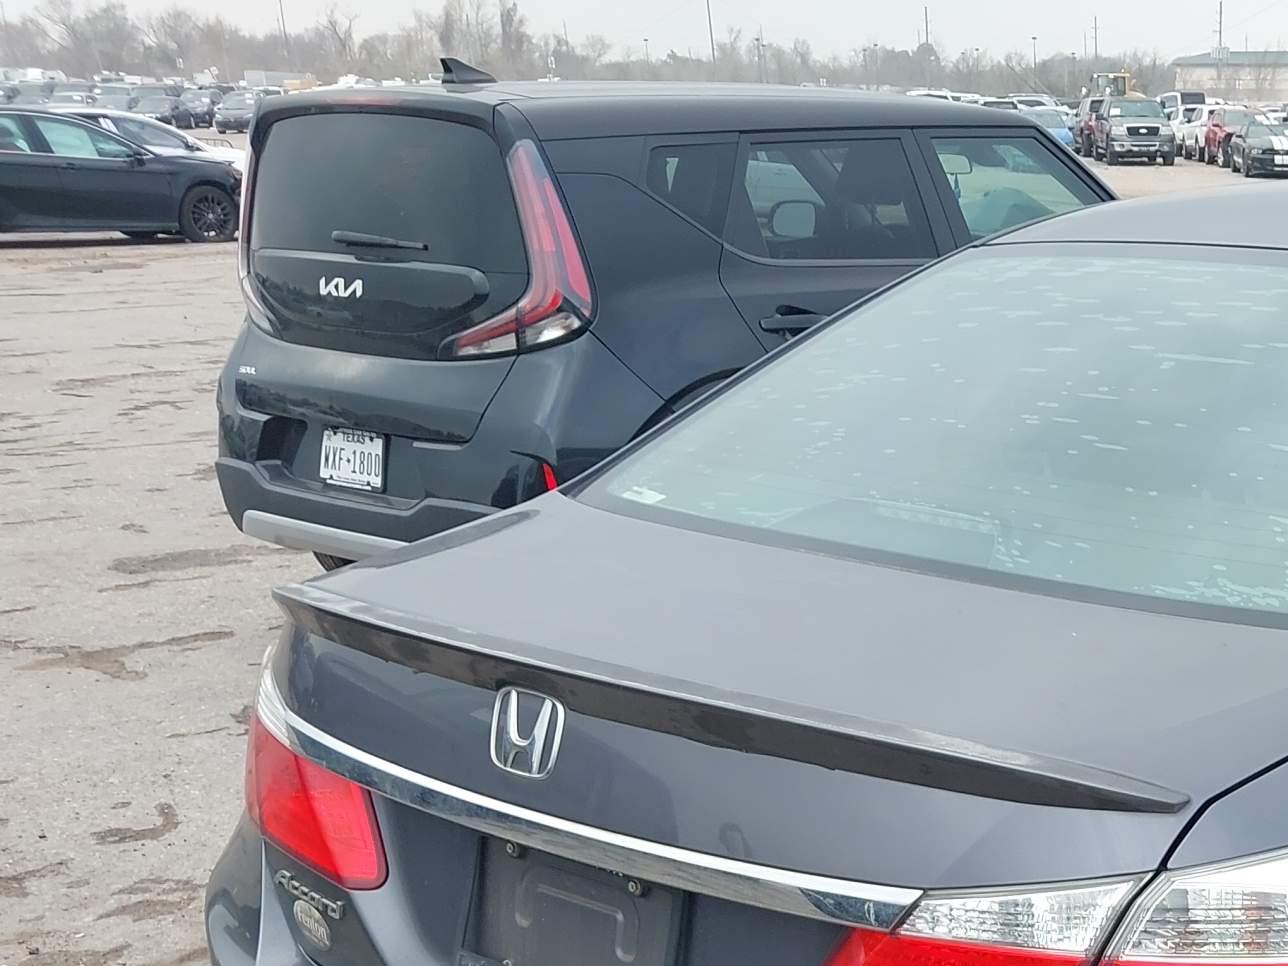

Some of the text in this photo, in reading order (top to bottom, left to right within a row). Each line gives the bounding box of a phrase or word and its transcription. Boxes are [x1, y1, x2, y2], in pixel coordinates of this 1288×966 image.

[319, 276, 363, 299] KIA
[342, 431, 366, 445] TEXAS
[273, 869, 345, 920] Accord
